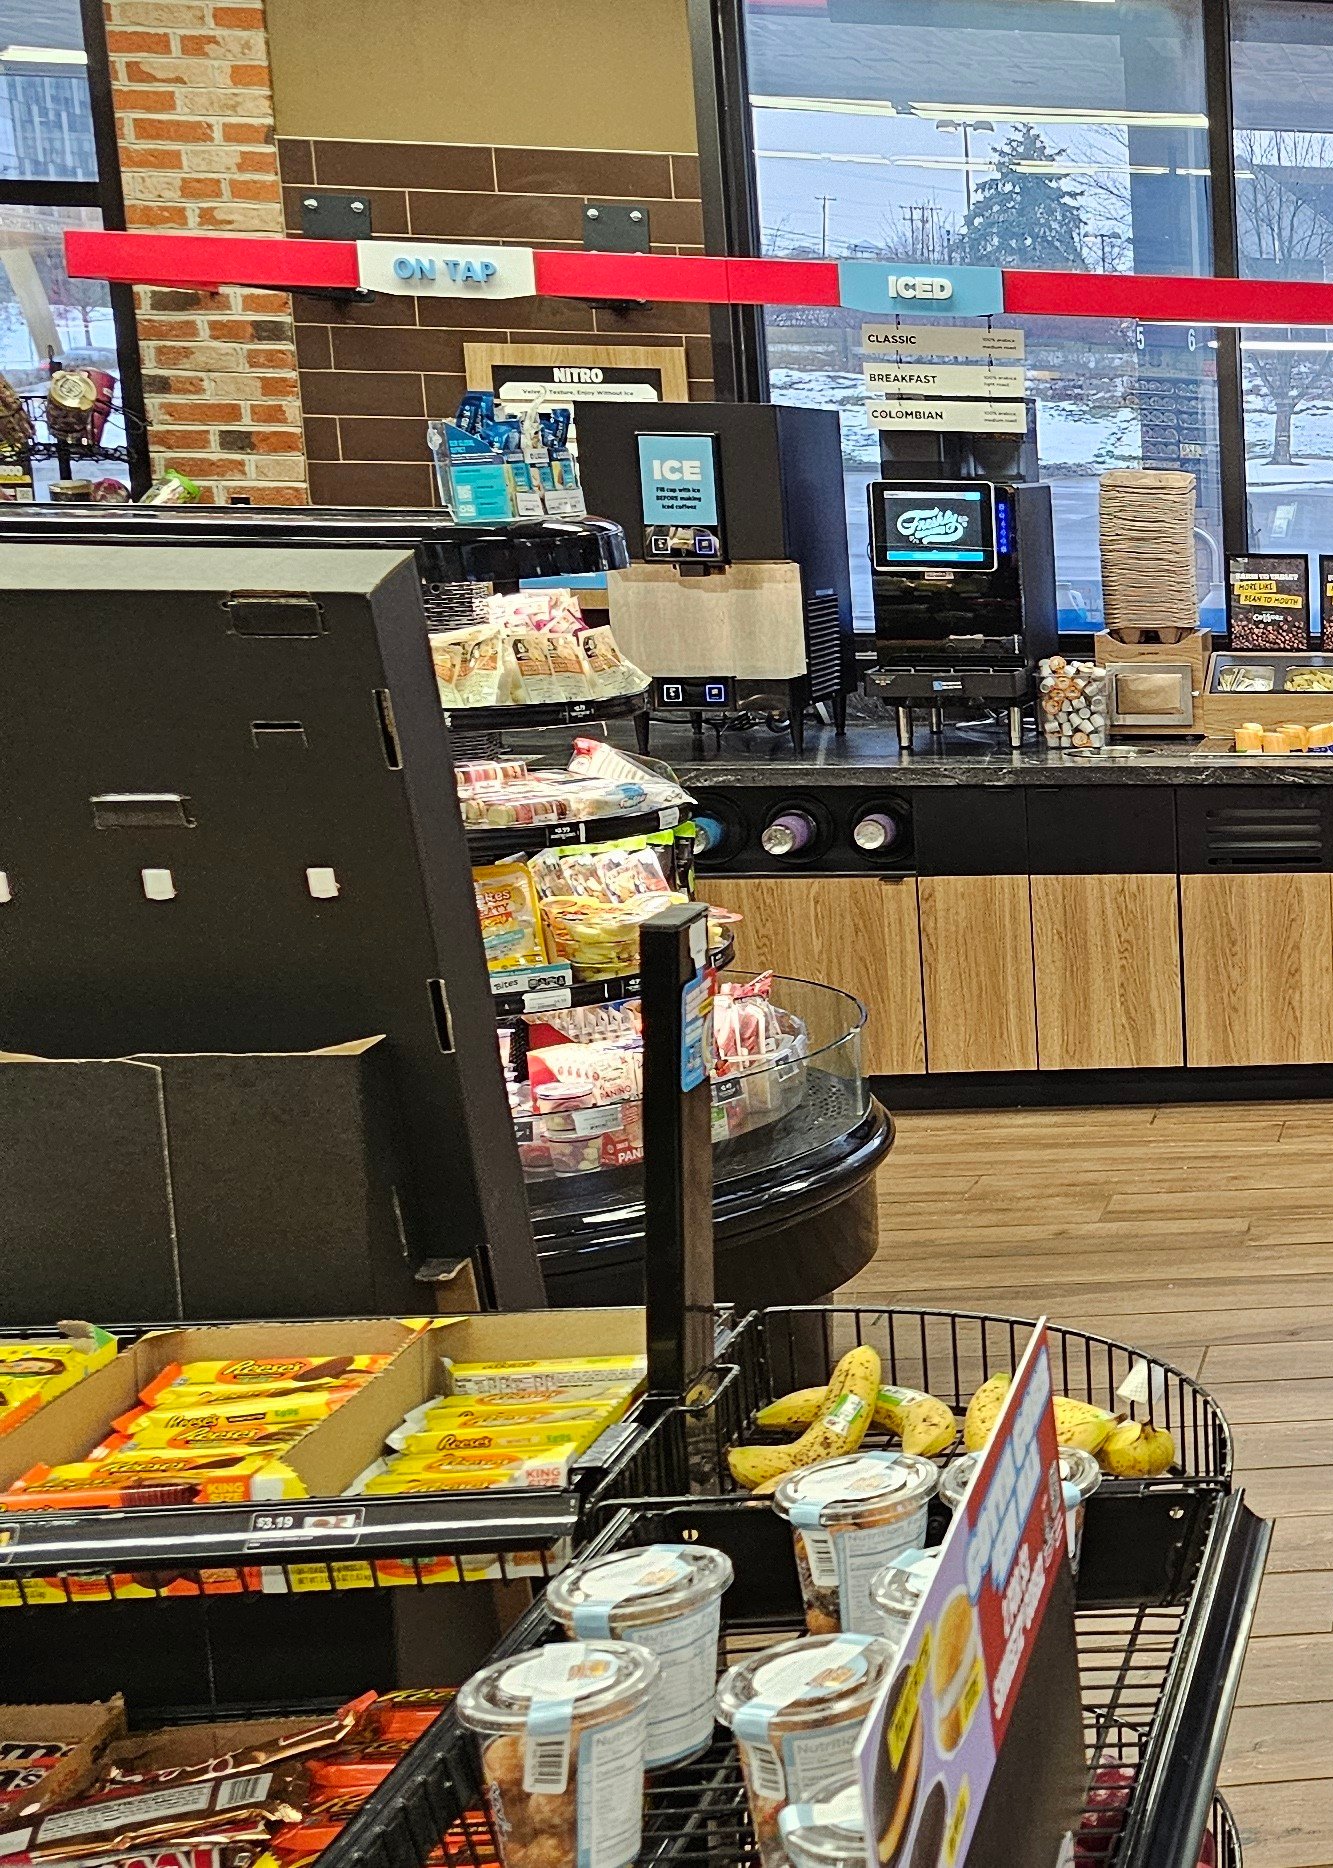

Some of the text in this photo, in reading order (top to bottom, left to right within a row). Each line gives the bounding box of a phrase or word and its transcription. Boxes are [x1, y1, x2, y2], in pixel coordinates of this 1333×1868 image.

[393, 256, 498, 284] ON TAP
[887, 275, 953, 300] ICED
[867, 333, 917, 345] CLASSIC
[1136, 327, 1145, 350] 5
[1188, 329, 1196, 351] 6
[552, 367, 604, 383] NITRO
[869, 373, 938, 384] BREAKFAST
[871, 409, 944, 421] COLOMBIAN
[652, 459, 702, 481] ICE
[1243, 594, 1299, 605] BEAN TO MOUTH
[600, 1085, 632, 1099] PANINO
[222, 1360, 305, 1375] Reese's
[438, 1434, 493, 1450] Reese's
[525, 1468, 561, 1477] KING
[207, 1482, 246, 1492] KING
[256, 1516, 293, 1529] $3.19
